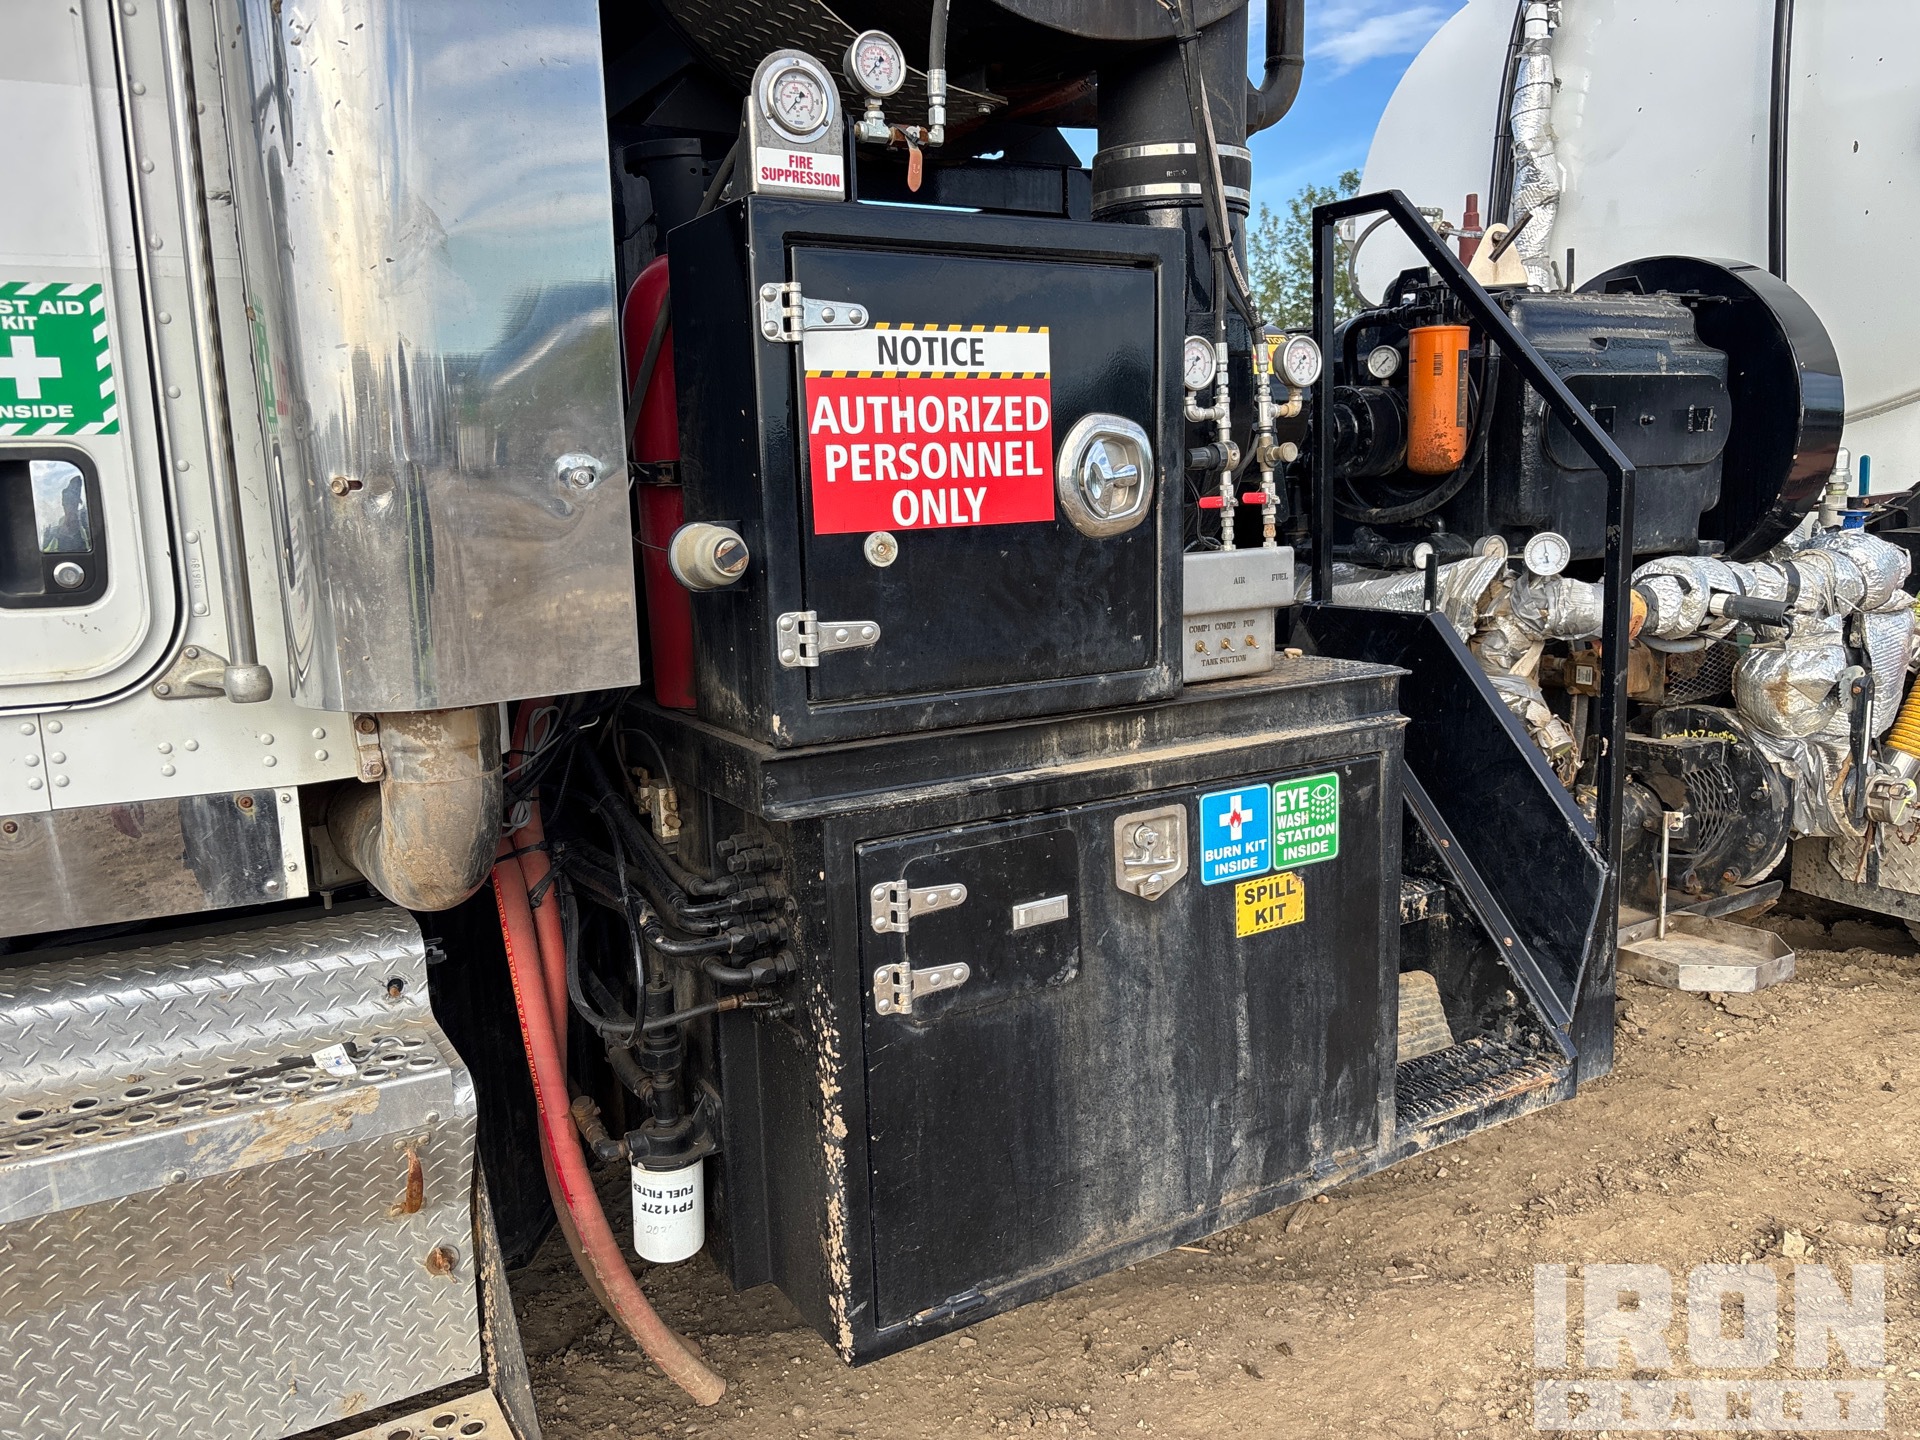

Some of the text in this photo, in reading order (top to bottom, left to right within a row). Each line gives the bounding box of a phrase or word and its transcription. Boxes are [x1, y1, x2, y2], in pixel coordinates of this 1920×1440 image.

[789, 154, 813, 170] FIRE
[761, 167, 840, 187] SUPPRESSION
[38, 300, 84, 315] AID
[2, 316, 38, 330] KIT
[877, 335, 985, 367] NOTICE
[0, 405, 74, 418] NSIDE
[811, 395, 1049, 435] AUTHORIZED
[825, 441, 1043, 482] PERSONNEL
[892, 487, 987, 527] ONLY
[1233, 576, 1245, 585] AIR
[1271, 573, 1288, 581] FUEL
[1189, 623, 1211, 633] COMP1
[1215, 621, 1236, 631] COMP2
[1201, 654, 1247, 667] TANK SUCTION
[1276, 786, 1310, 813] EYE
[1277, 811, 1309, 830] WASH
[1277, 822, 1335, 845] STATION
[1205, 839, 1267, 862] BURN KIT
[1283, 840, 1329, 861] INSIDE
[1215, 856, 1258, 876] INSIDE
[1244, 879, 1296, 905] SPILL
[1255, 903, 1286, 926] KIT
[508, 956, 519, 985] STEAM
[514, 987, 523, 1005] MAX
[528, 1060, 539, 1085] MADE
[666, 1184, 694, 1198] FUEL
[641, 1199, 694, 1215] FP1127F
